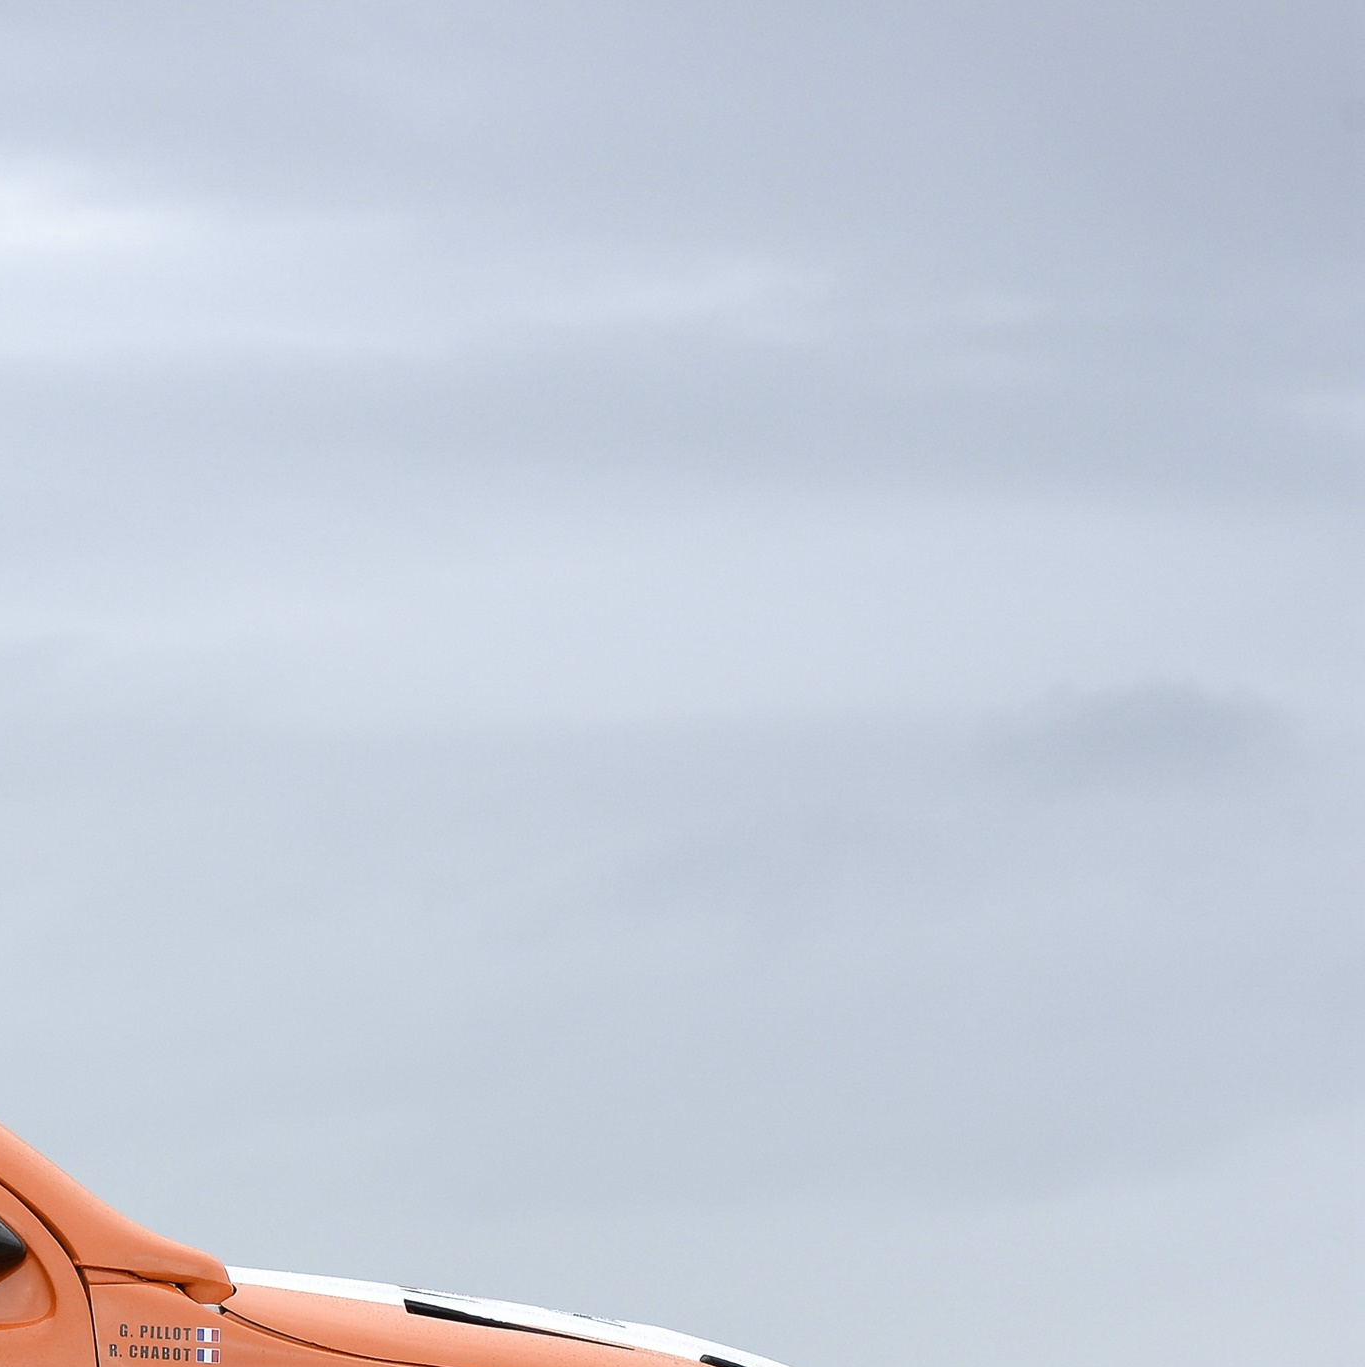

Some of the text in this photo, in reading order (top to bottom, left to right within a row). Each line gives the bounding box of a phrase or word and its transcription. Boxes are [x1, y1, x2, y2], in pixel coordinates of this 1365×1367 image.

[119, 1323, 192, 1341] G. PILLOT
[109, 1343, 192, 1362] R. CHABOT
